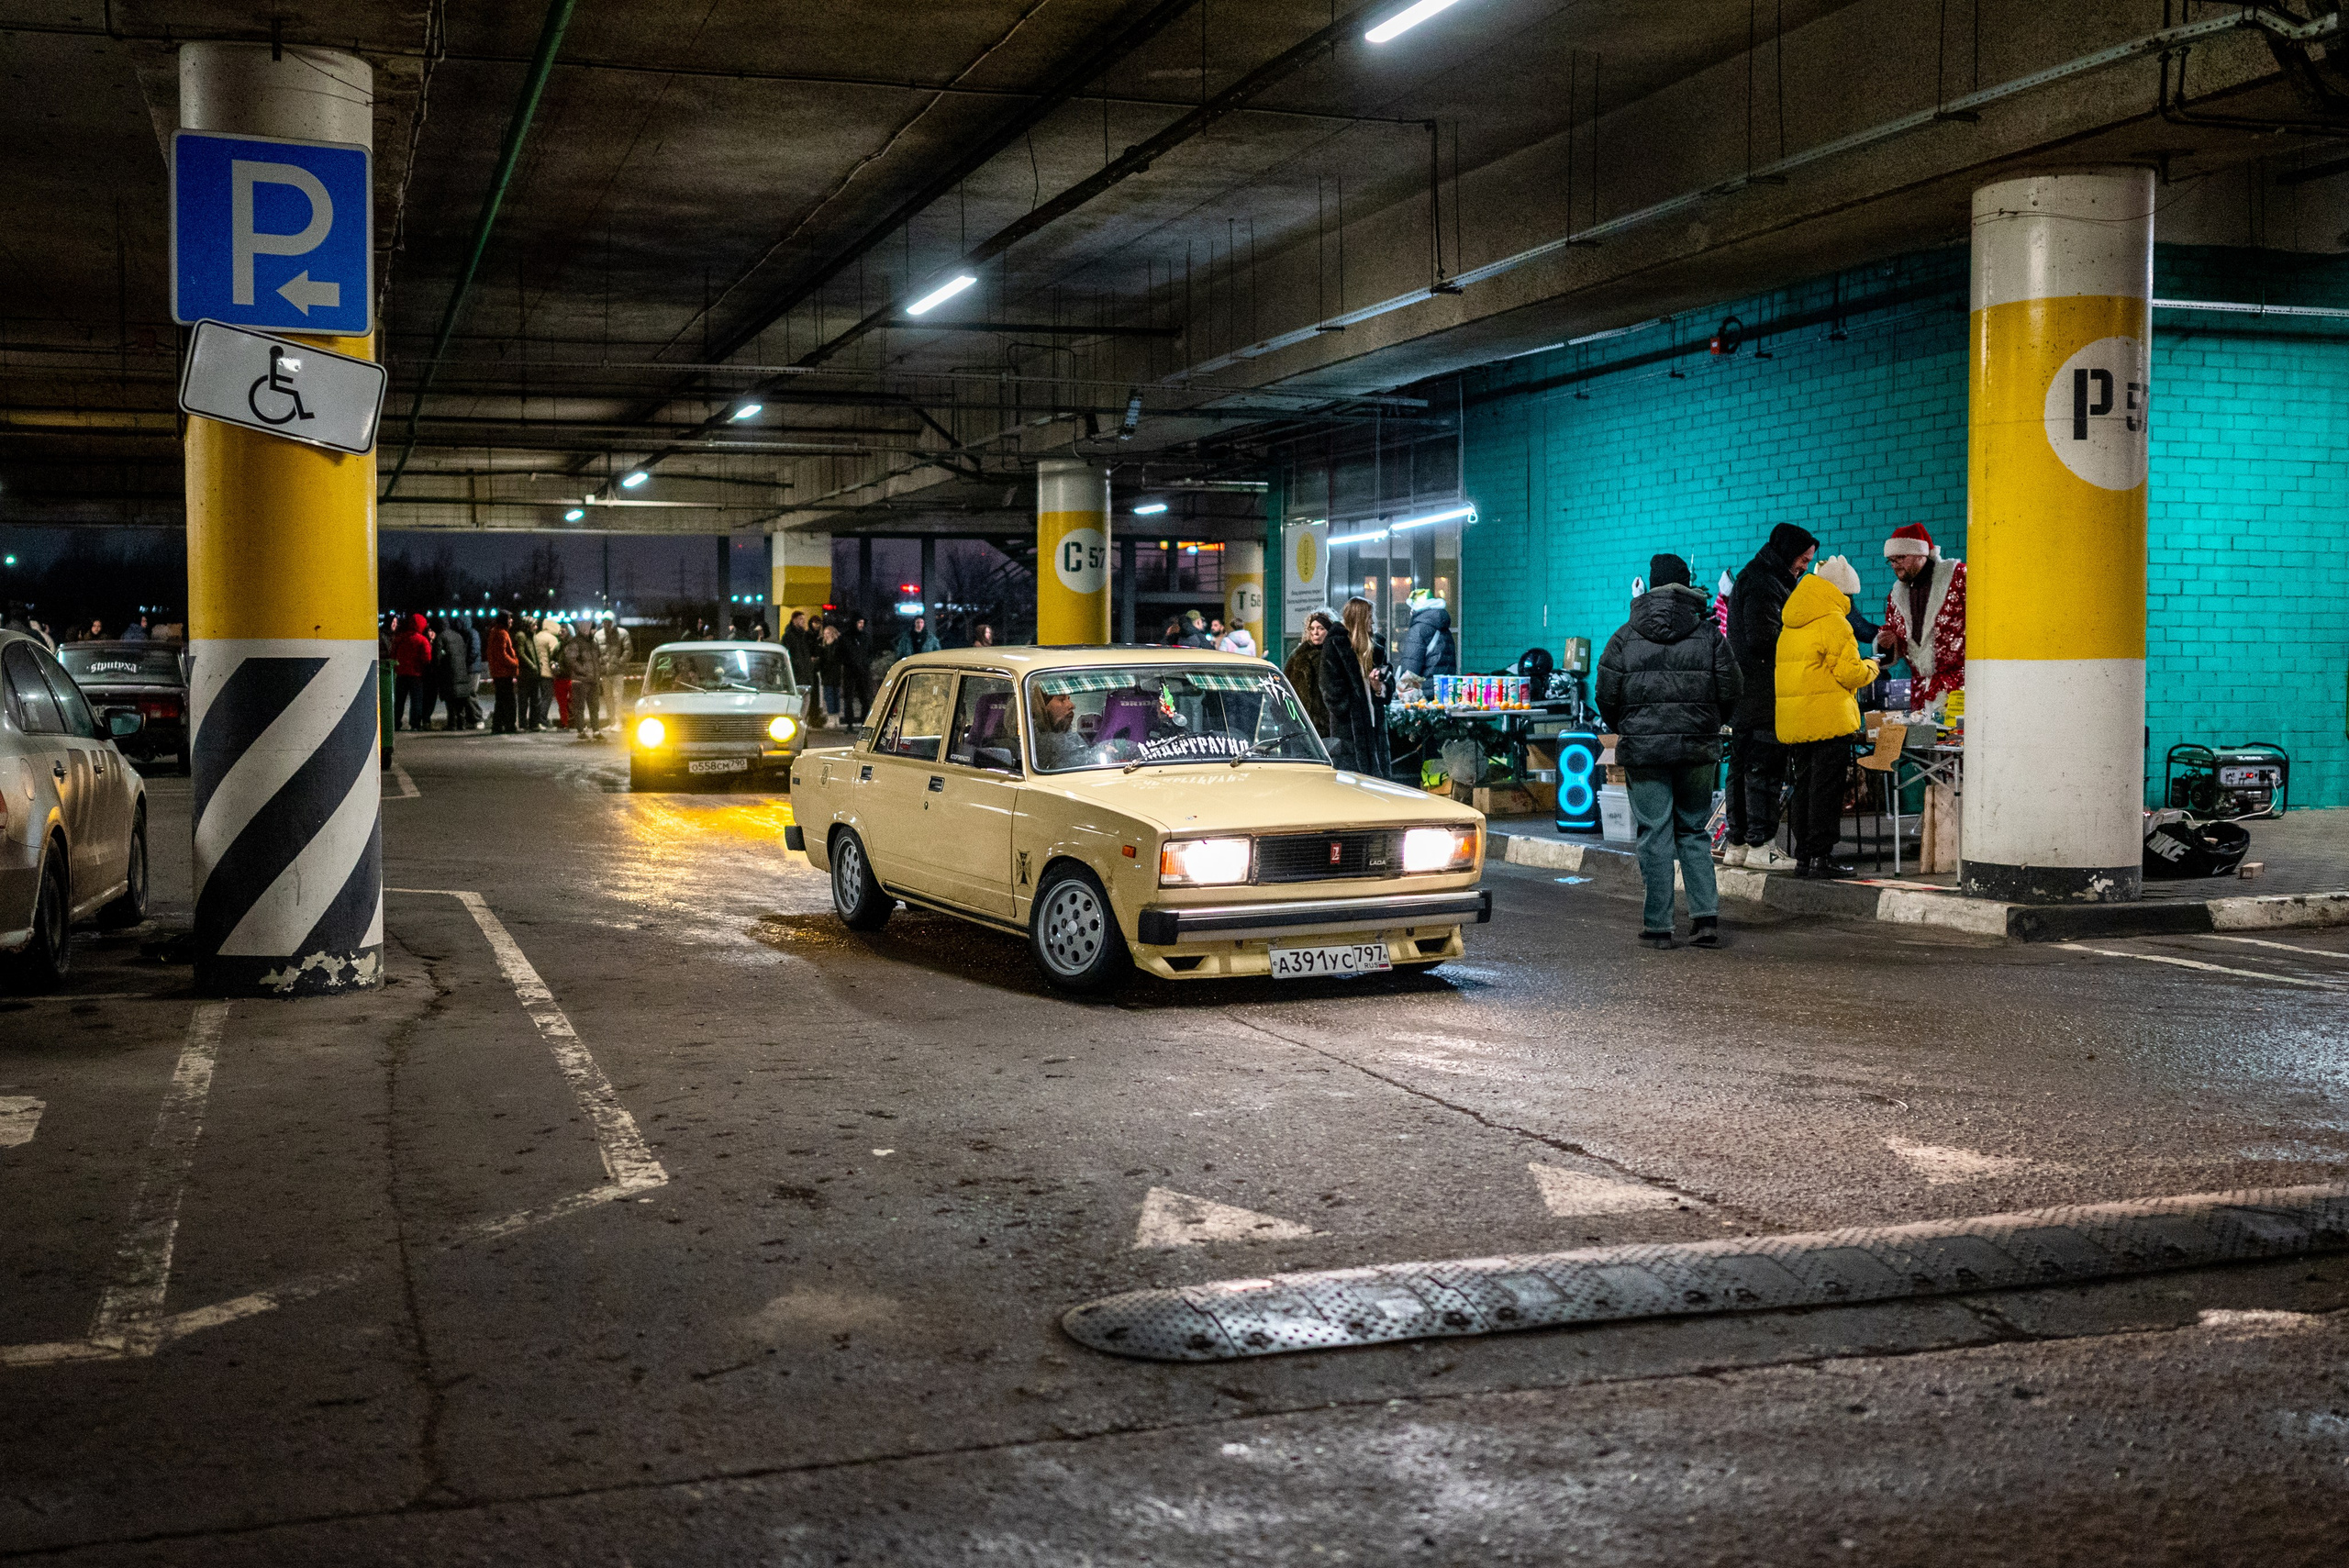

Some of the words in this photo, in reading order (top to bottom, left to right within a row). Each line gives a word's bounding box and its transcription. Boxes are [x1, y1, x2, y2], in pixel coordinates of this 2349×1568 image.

[231, 159, 334, 306] P
[2074, 369, 2114, 440] P
[1064, 541, 1082, 573] C
[1089, 546, 1106, 569] 57
[1238, 591, 1246, 610] T
[2146, 830, 2192, 863] NIKE
[1353, 945, 1383, 962] 797
[1364, 961, 1379, 969] RUS
